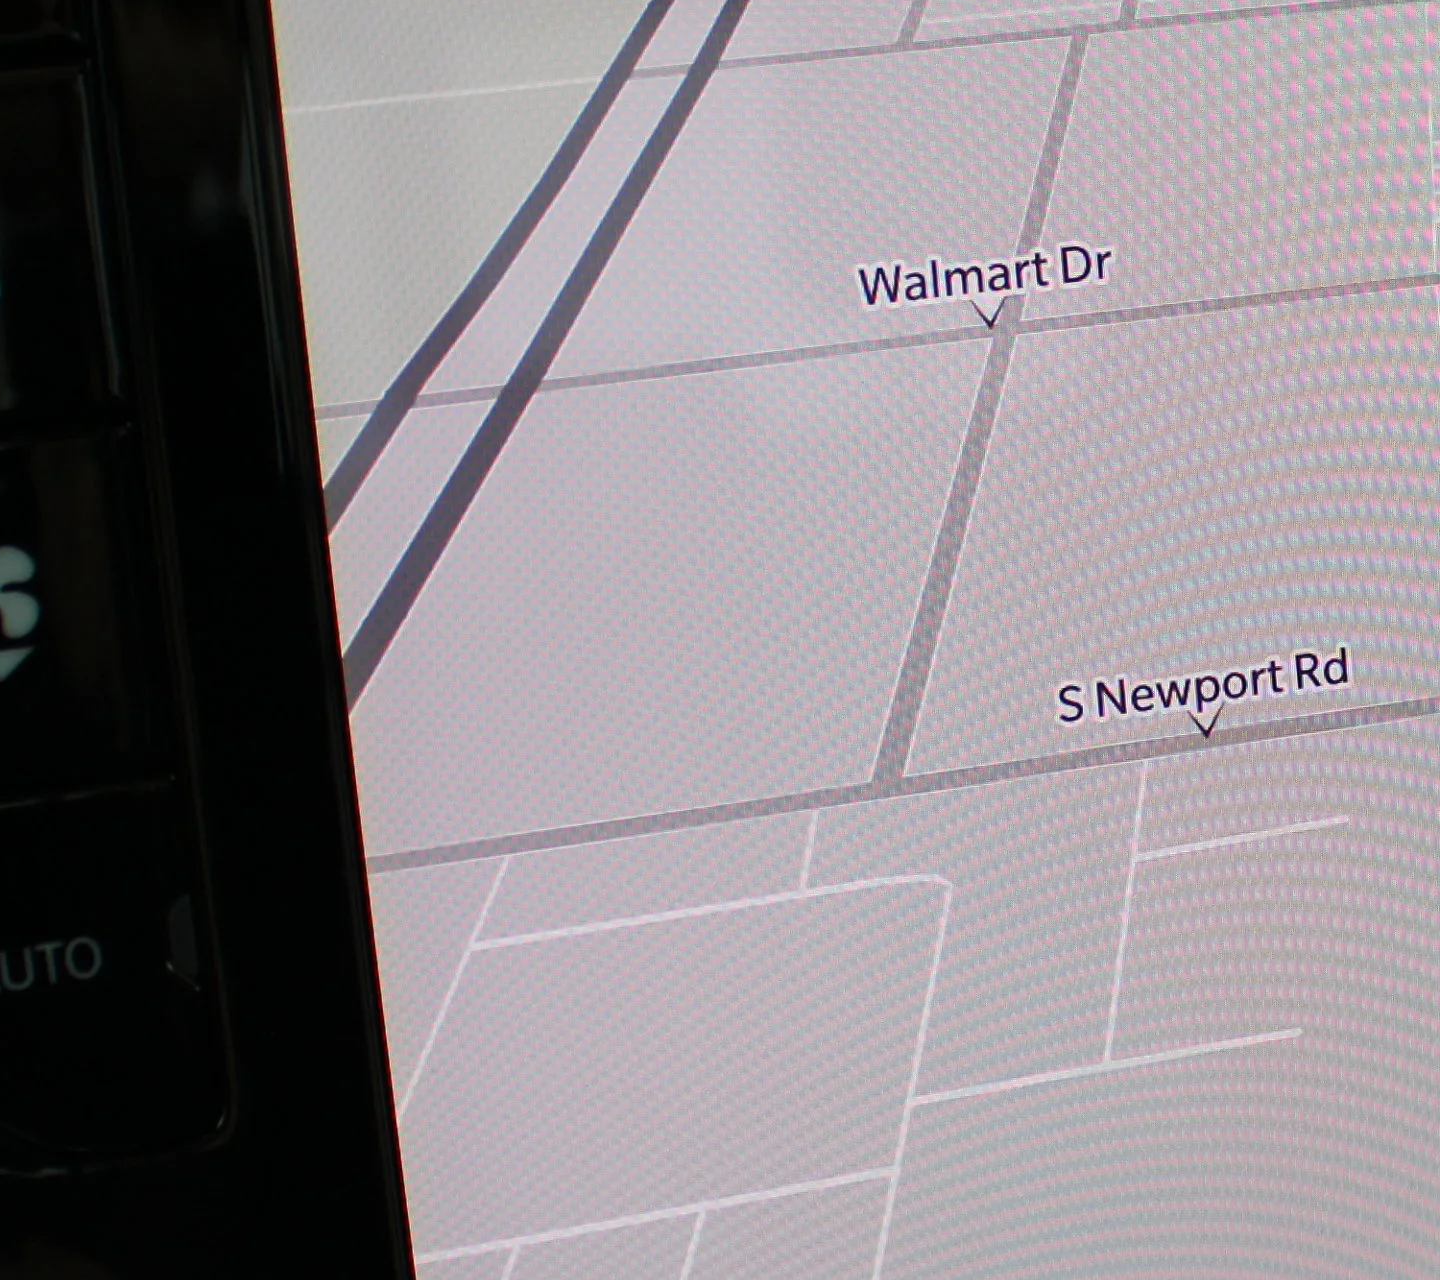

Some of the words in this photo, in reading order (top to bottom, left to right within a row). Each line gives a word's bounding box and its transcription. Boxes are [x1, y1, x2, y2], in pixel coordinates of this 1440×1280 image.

[859, 251, 1049, 305] Walmart
[1060, 245, 1112, 284] Dr
[1058, 684, 1084, 722] S
[1095, 659, 1284, 718] Newport
[1294, 647, 1349, 690] Rd
